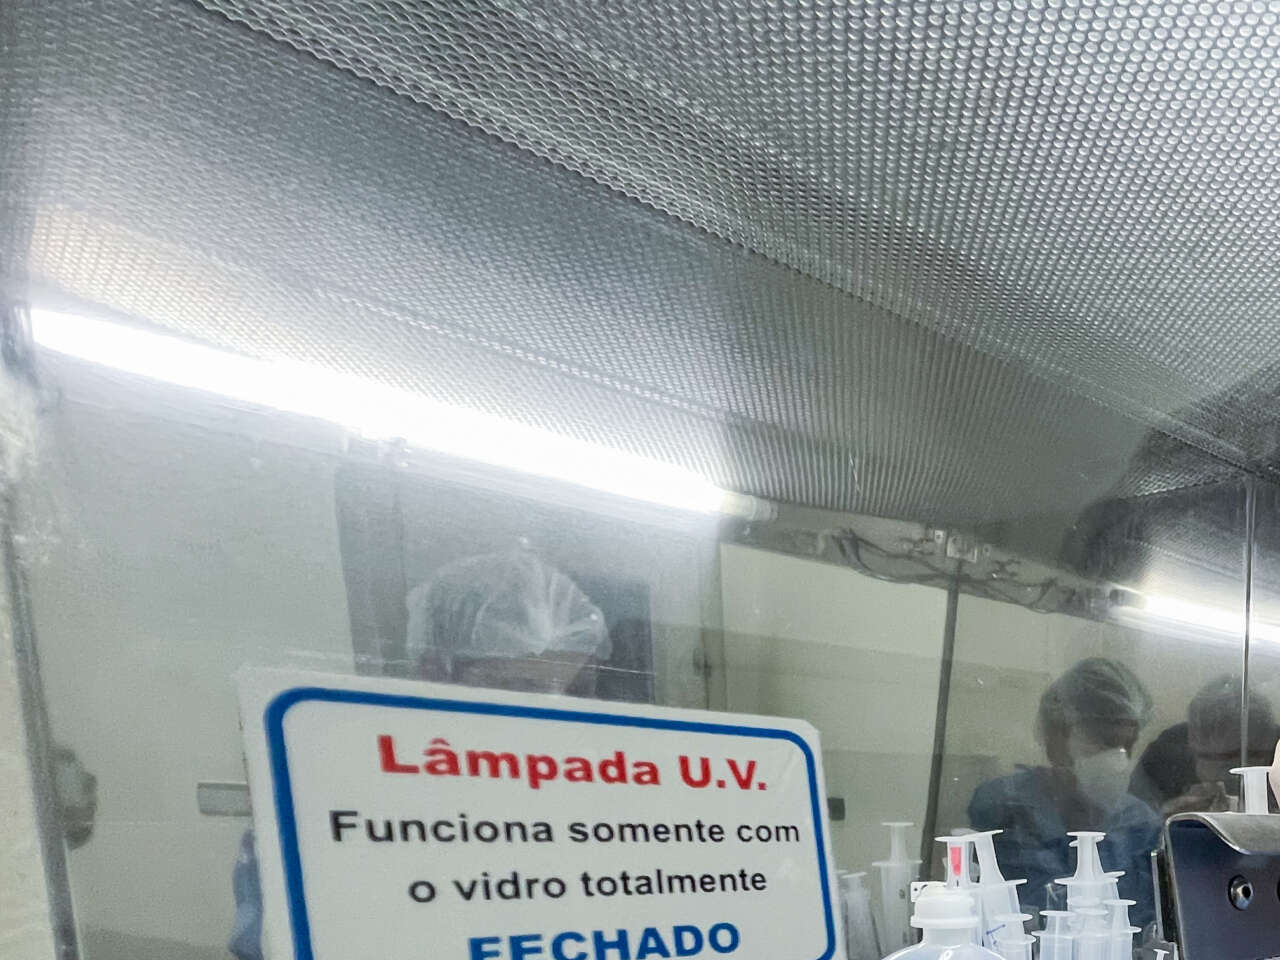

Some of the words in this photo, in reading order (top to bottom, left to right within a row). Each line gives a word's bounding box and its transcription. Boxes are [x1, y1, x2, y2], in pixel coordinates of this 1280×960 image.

[376, 733, 661, 790] Lâmpada
[677, 755, 768, 790] U.V.
[327, 809, 554, 844] Funciona
[568, 820, 726, 844] somente
[737, 822, 802, 844] com
[408, 878, 436, 904] o
[453, 871, 568, 902] vidro
[581, 867, 768, 898] totalmente
